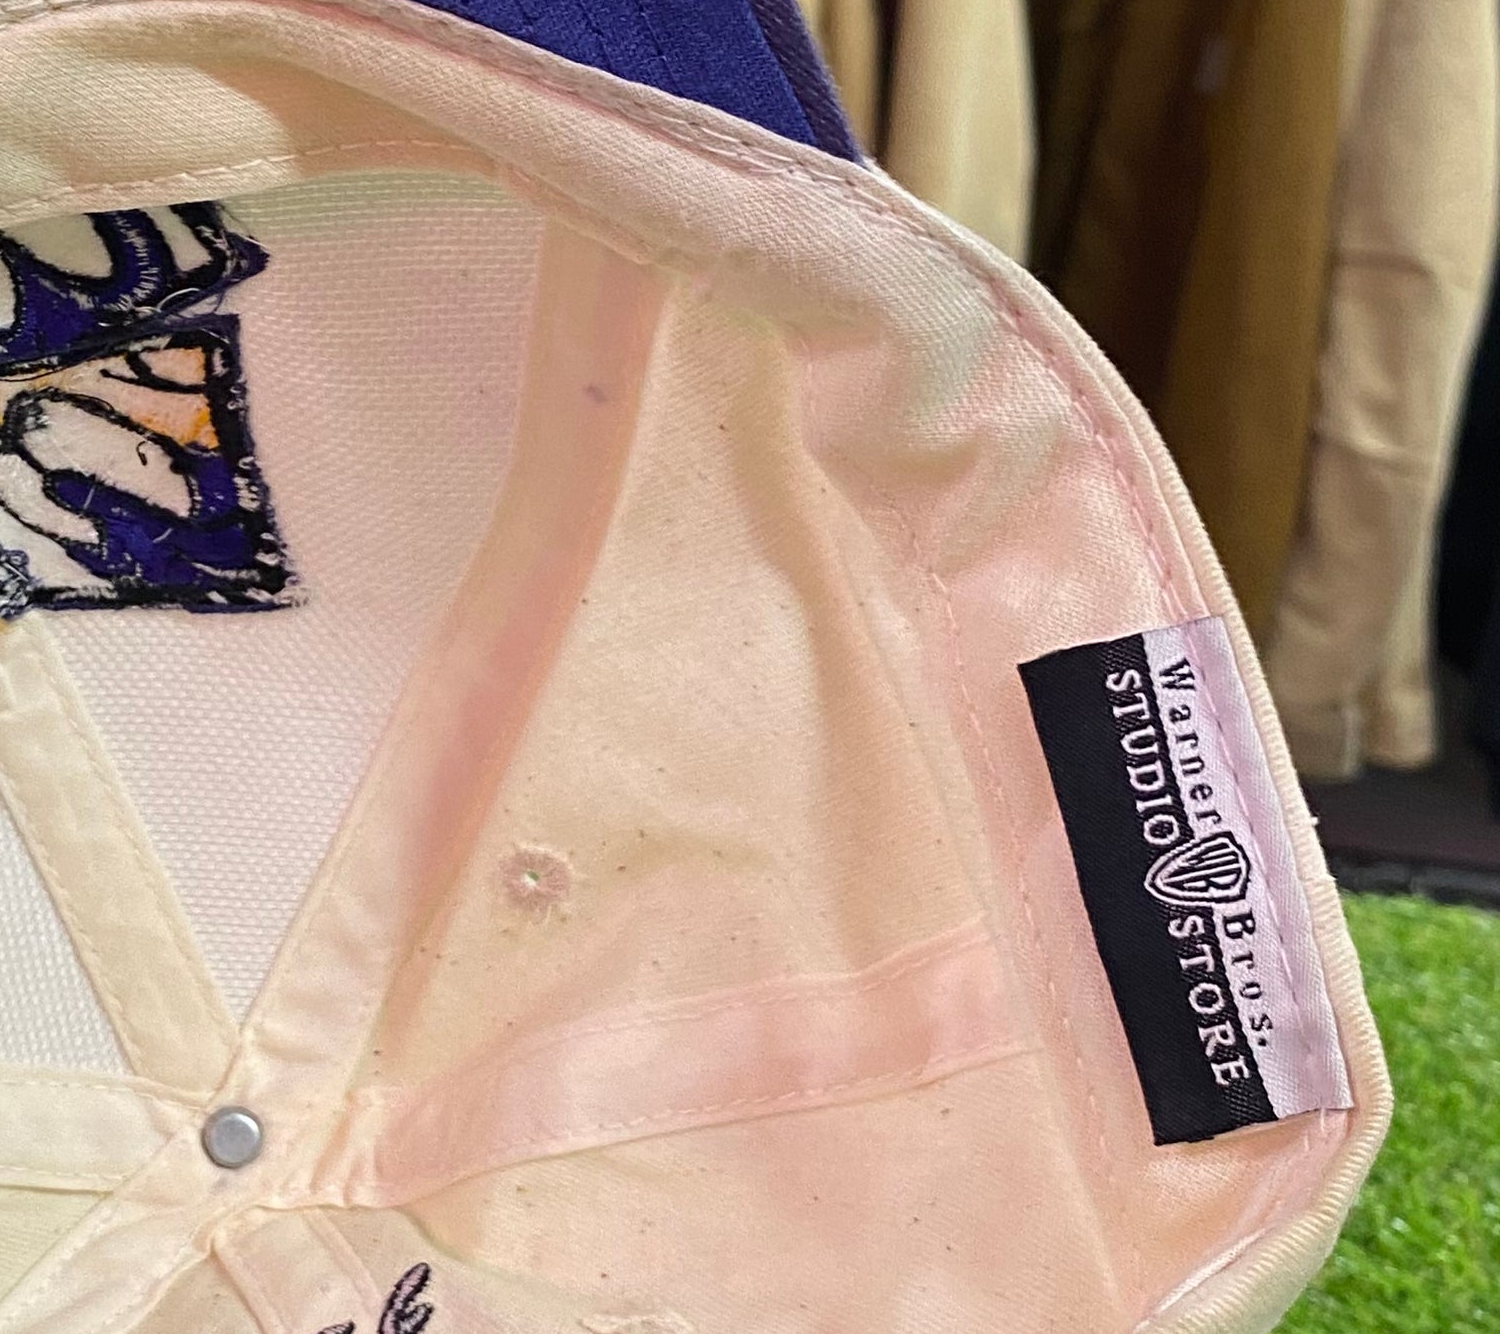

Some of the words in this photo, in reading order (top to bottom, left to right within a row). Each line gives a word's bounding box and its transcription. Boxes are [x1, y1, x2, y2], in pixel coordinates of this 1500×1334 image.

[1105, 668, 1181, 846] STUDIO
[1167, 914, 1251, 1086] STORE
[1159, 657, 1222, 826] Warner
[1223, 906, 1275, 1048] Bros.
